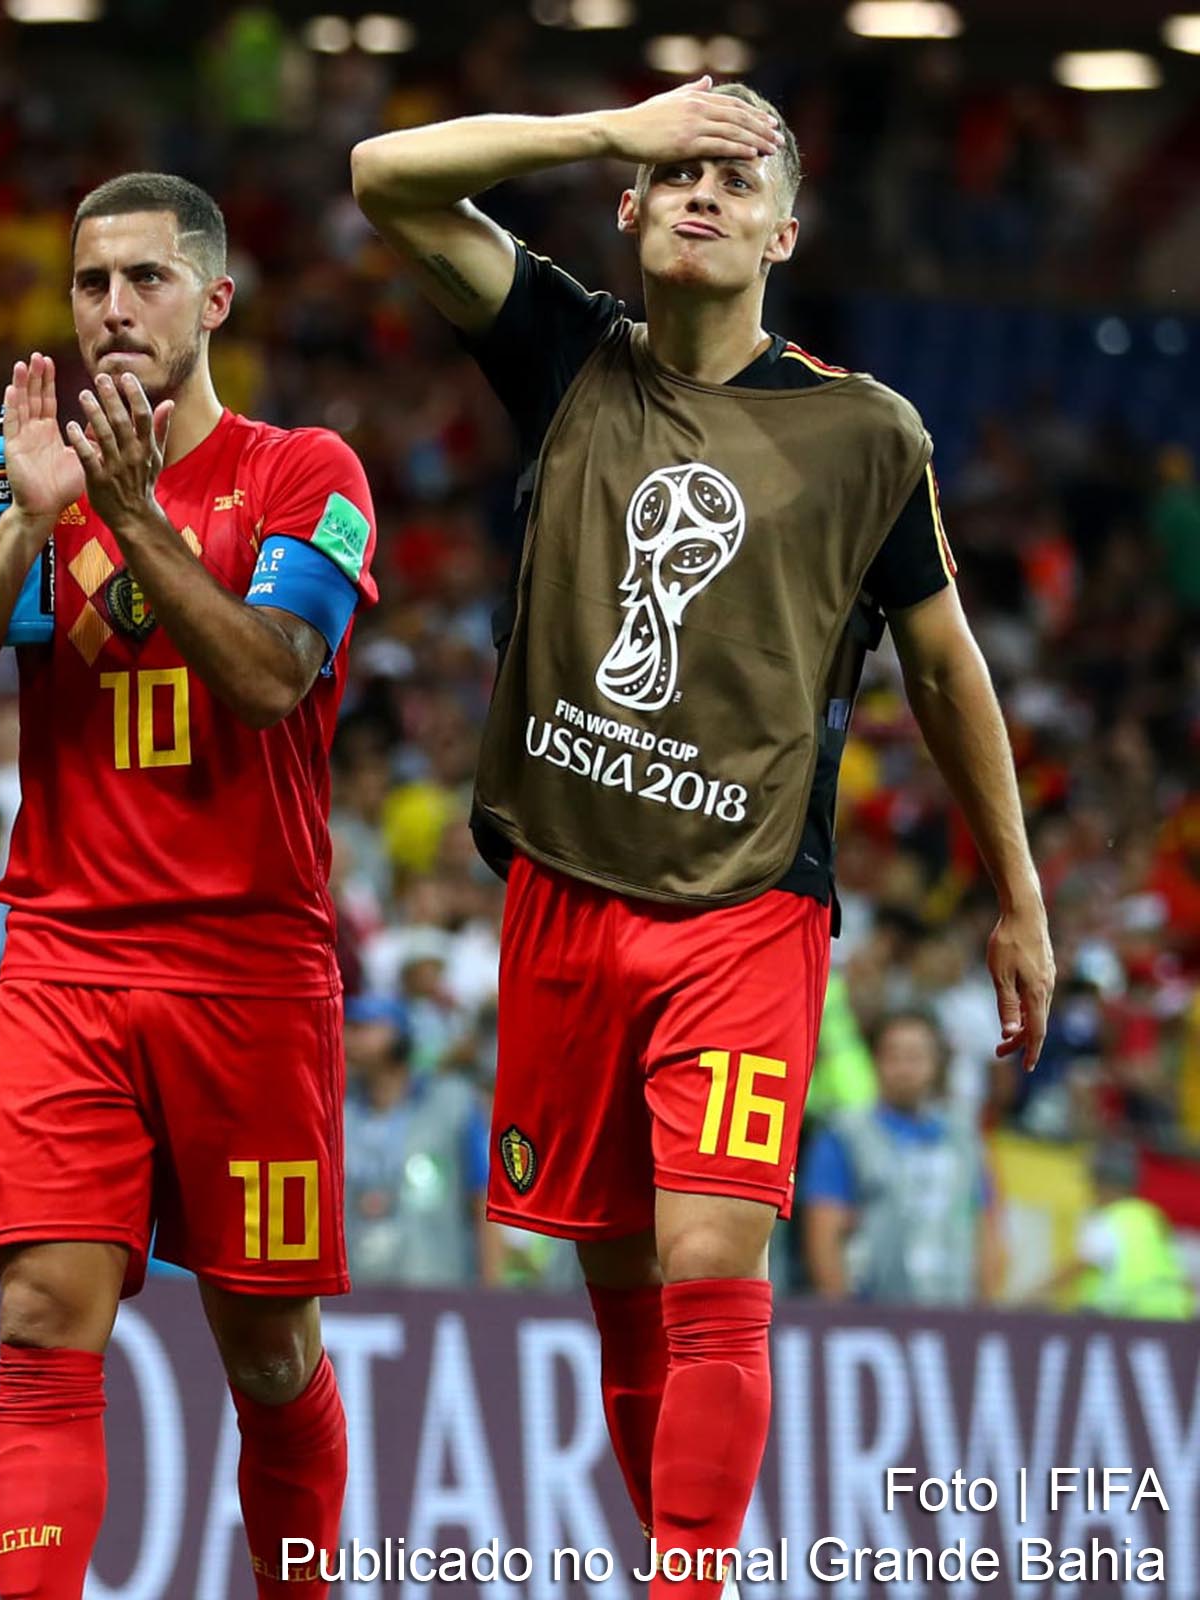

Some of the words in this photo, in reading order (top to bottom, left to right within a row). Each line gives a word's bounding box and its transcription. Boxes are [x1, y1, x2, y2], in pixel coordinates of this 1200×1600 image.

[100, 667, 191, 769] 10
[525, 716, 634, 793] USSIA
[638, 763, 748, 822] 2018
[555, 699, 584, 728] FIFA
[587, 714, 656, 751] WORLD
[658, 738, 700, 762] CUP
[698, 1050, 787, 1166] 16
[228, 1160, 319, 1260] 10
